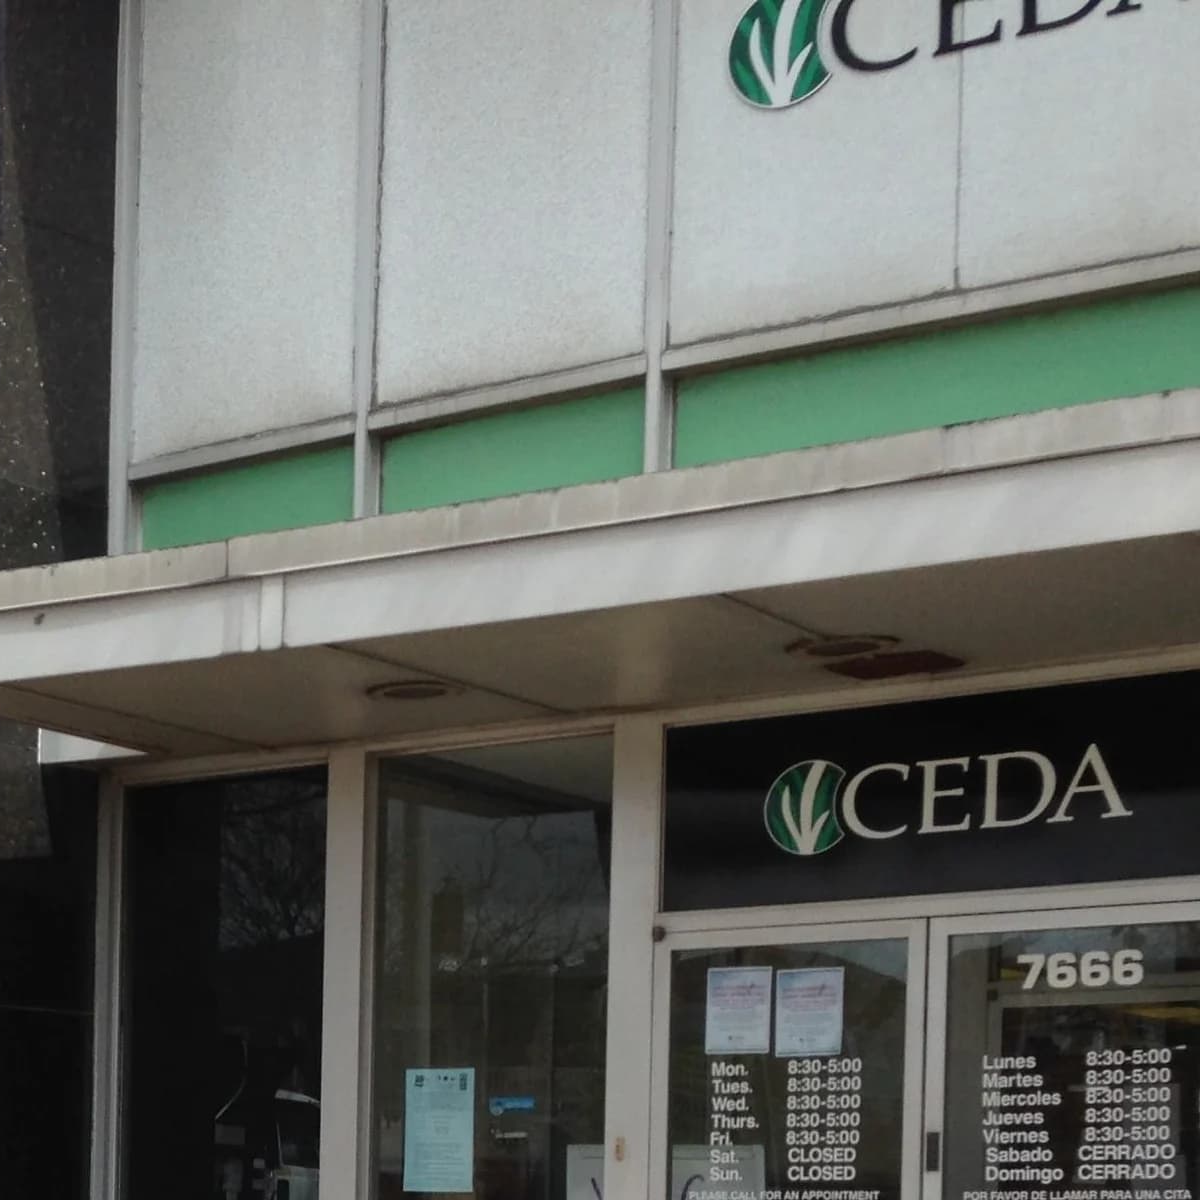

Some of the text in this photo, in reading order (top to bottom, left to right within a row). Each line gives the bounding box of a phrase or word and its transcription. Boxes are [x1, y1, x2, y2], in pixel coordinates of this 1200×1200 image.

[831, 0, 1193, 72] CE
[842, 743, 1133, 839] CEDA
[1017, 949, 1144, 990] 7666
[711, 1058, 862, 1076] Mon. 8:30-5:00
[982, 1048, 1172, 1070] Lunes 8:30-5:00
[711, 1076, 862, 1094] Tues. 8:30-5:00
[982, 1067, 1171, 1089] Martes 8:30-5:00
[712, 1094, 861, 1111] Wed. 8:30-5:00
[981, 1087, 1171, 1107] Miercoles 8:30-5:00
[711, 1112, 861, 1129] Thurs. 8:30-5:00
[982, 1106, 1171, 1126] Jueves 8:30-5:00
[710, 1130, 860, 1146] Fri. 8:30-5:00
[982, 1125, 1170, 1144] Viernes 8:30-5:00
[710, 1147, 857, 1164] Sat. CLOSED
[986, 1143, 1176, 1163] Sabado CERRADO
[709, 1165, 856, 1181] Sun. CLOSED
[984, 1163, 1176, 1185] Domingo CERRADO
[689, 1191, 880, 1200] PLEASE CALL FOR AN APPOINTMENT
[963, 1189, 1192, 1200] POR FAVOR DE LLAMAR PARA UNA CITA
